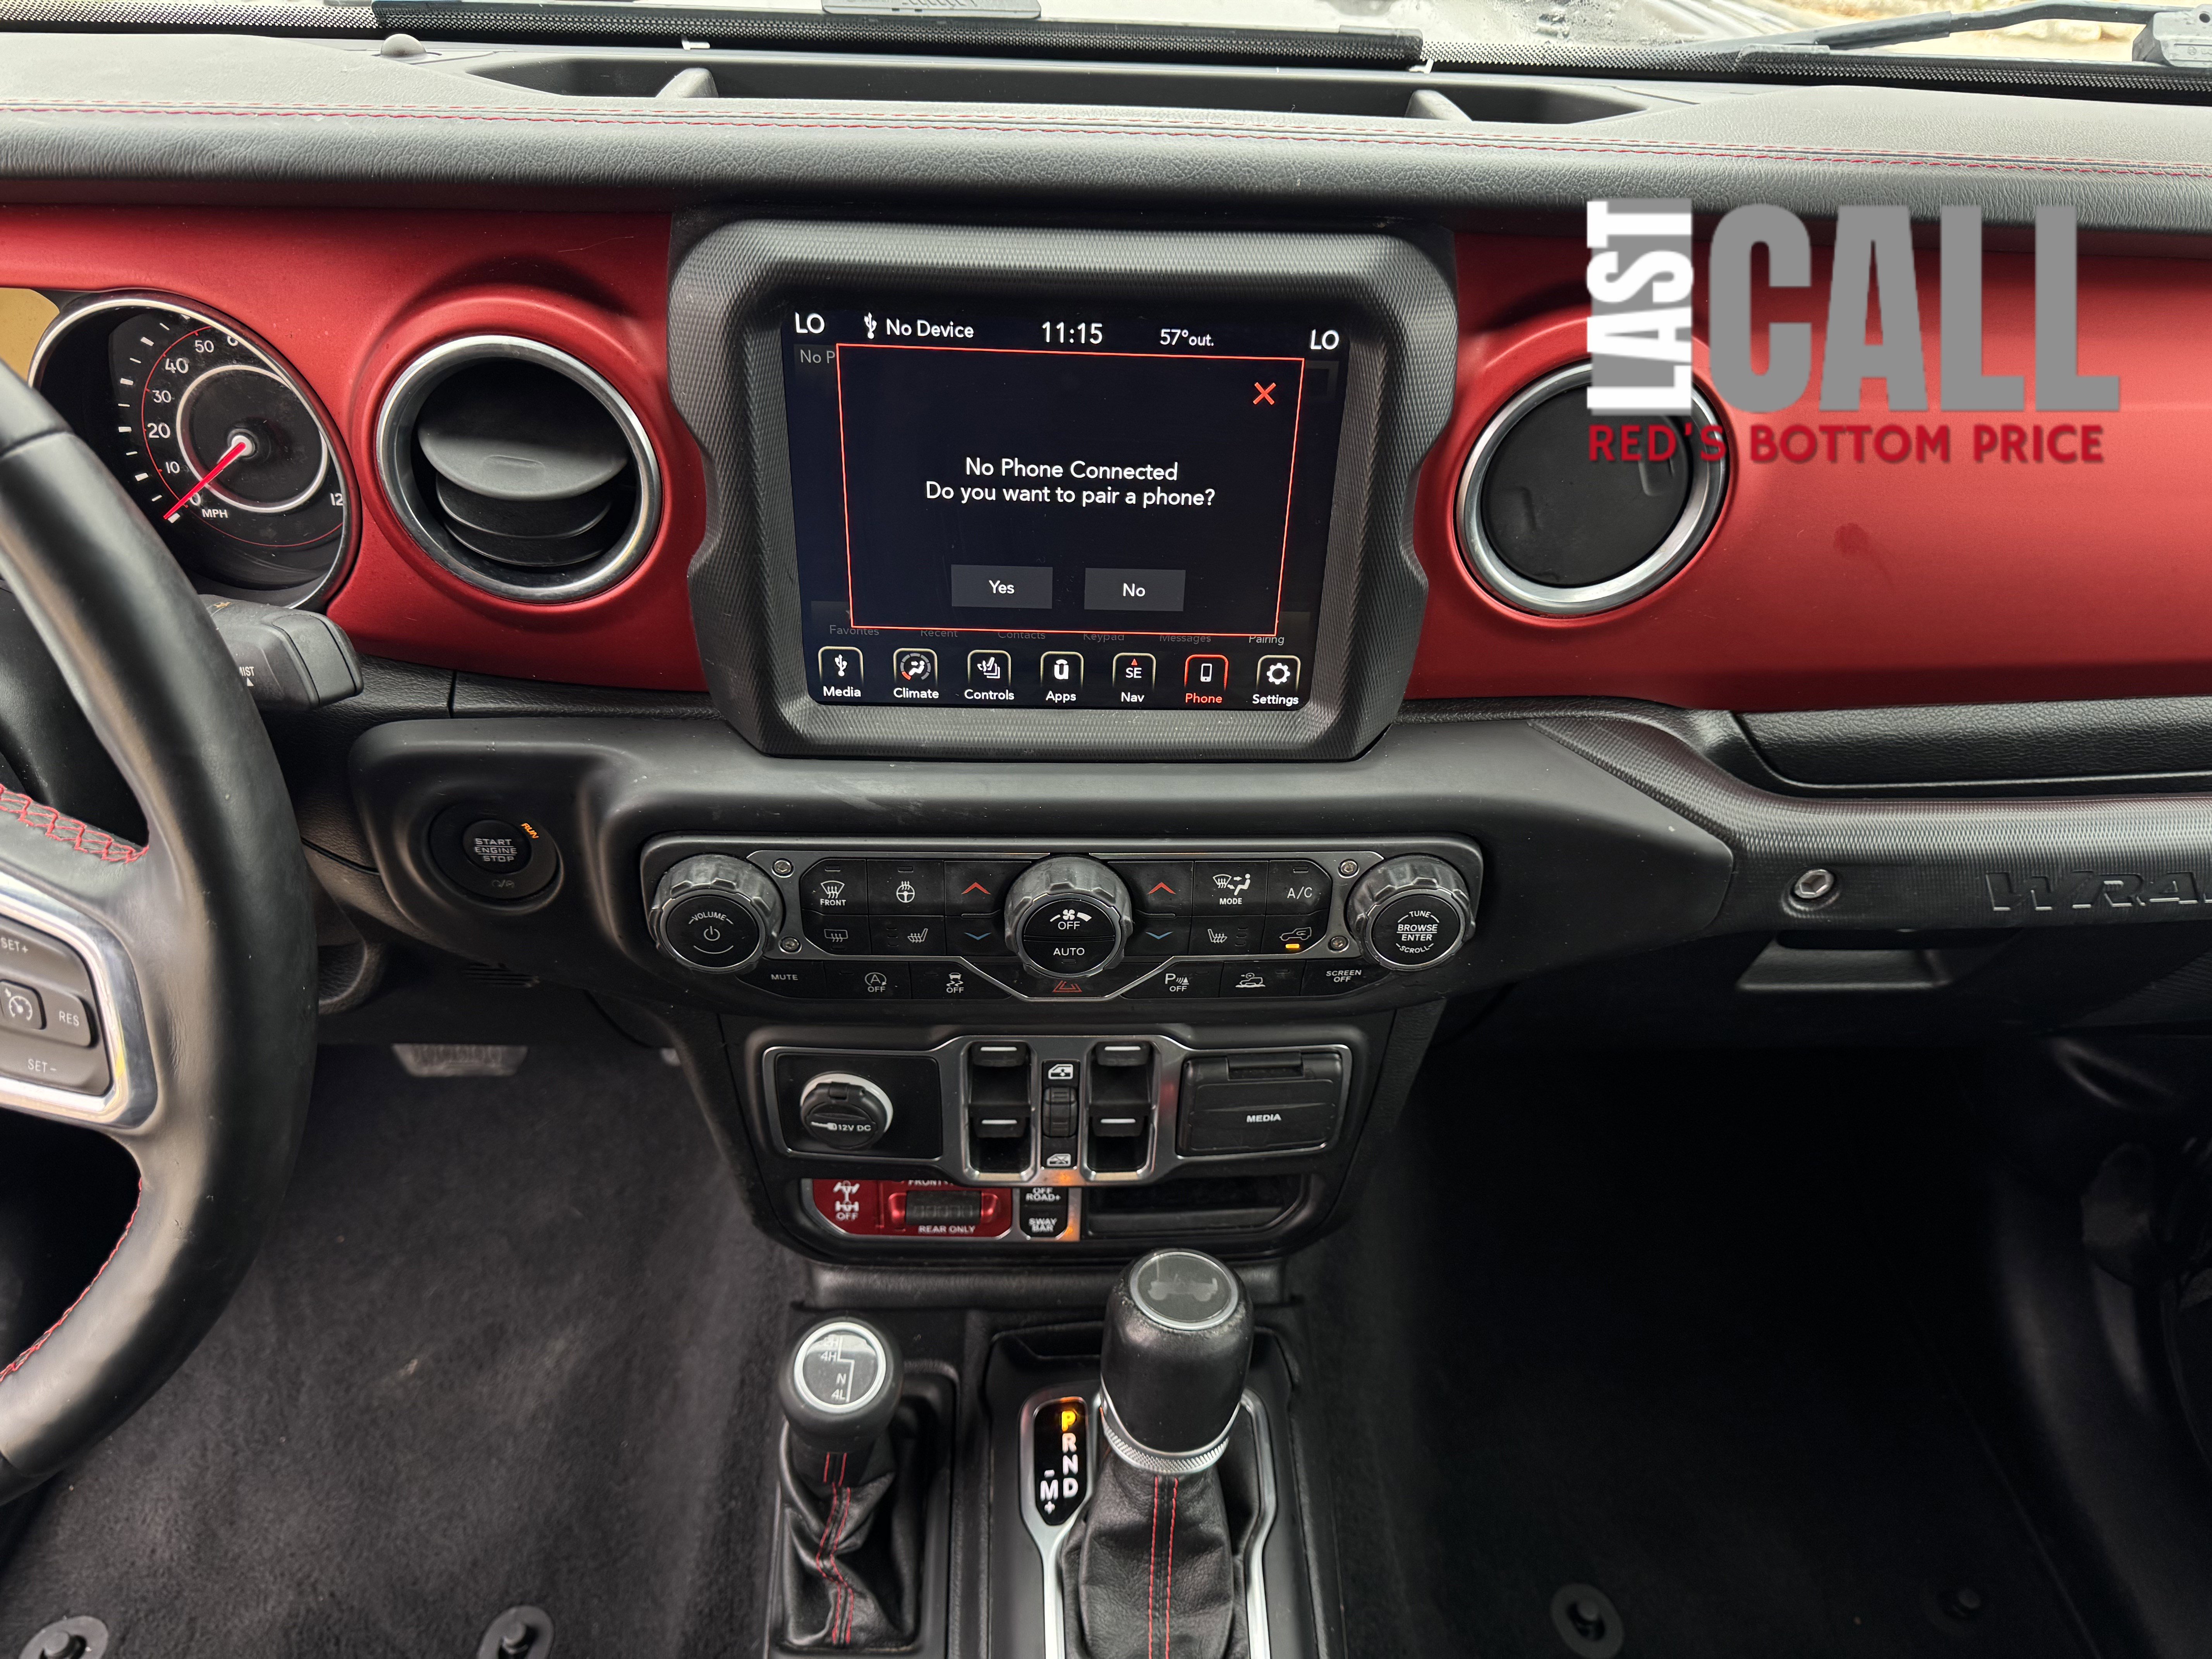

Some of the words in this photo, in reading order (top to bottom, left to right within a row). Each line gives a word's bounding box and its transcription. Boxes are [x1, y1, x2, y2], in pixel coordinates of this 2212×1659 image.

[795, 313, 825, 334] LO
[886, 319, 912, 336] No
[917, 320, 974, 338] Device
[1042, 321, 1103, 344] 11:15
[1310, 330, 1339, 350] LO
[195, 340, 214, 353] 50
[800, 350, 821, 363] No
[165, 358, 189, 373] 40
[153, 390, 171, 403] 30
[147, 423, 170, 439] 20
[166, 462, 180, 474] 10
[966, 457, 994, 476] No
[1002, 459, 1063, 477] Phone
[1070, 461, 1178, 481] Connected
[926, 481, 954, 499] Do
[961, 484, 996, 503] you
[1003, 486, 1050, 502] want
[1056, 487, 1075, 503] to
[1083, 488, 1119, 507] pair
[1125, 491, 1136, 504] a
[1143, 488, 1215, 508] phone?
[202, 509, 228, 518] MPH
[989, 580, 1015, 594] Yes
[1123, 583, 1146, 597] No
[830, 625, 879, 635] Favorites
[1125, 667, 1142, 678] SE
[823, 686, 861, 697] Media
[893, 688, 939, 699] Climate
[964, 689, 1015, 701] Controls
[1046, 691, 1076, 703] Apps
[1121, 692, 1144, 702] Nav
[1185, 693, 1223, 704] Phone
[1252, 694, 1299, 707] Settings
[521, 823, 539, 839] RUN
[1287, 886, 1313, 900] A/C
[1986, 870, 2212, 911] WRA
[692, 911, 727, 922] VOLUME
[1409, 910, 1432, 919] TUNE
[1058, 921, 1080, 930] OFF
[1397, 924, 1438, 932] BROWSE
[1401, 933, 1432, 941] ENTER
[1053, 947, 1085, 956] AUTO
[1399, 944, 1431, 953] SCROLL
[59, 1010, 79, 1027] RES
[1246, 1113, 1281, 1123] MEDIA
[836, 1212, 859, 1221] OFF
[1029, 1218, 1058, 1226] SWAY
[918, 1225, 947, 1233] REAR
[949, 1225, 975, 1234] ONLY
[1032, 1224, 1054, 1233] BAR
[820, 1350, 837, 1362] 4H
[836, 1373, 847, 1385] N
[831, 1389, 846, 1401] 4L
[1061, 1411, 1076, 1431] P
[1062, 1433, 1077, 1452] R
[1063, 1454, 1078, 1475] N
[1041, 1479, 1058, 1501] M
[1063, 1477, 1078, 1498] D
